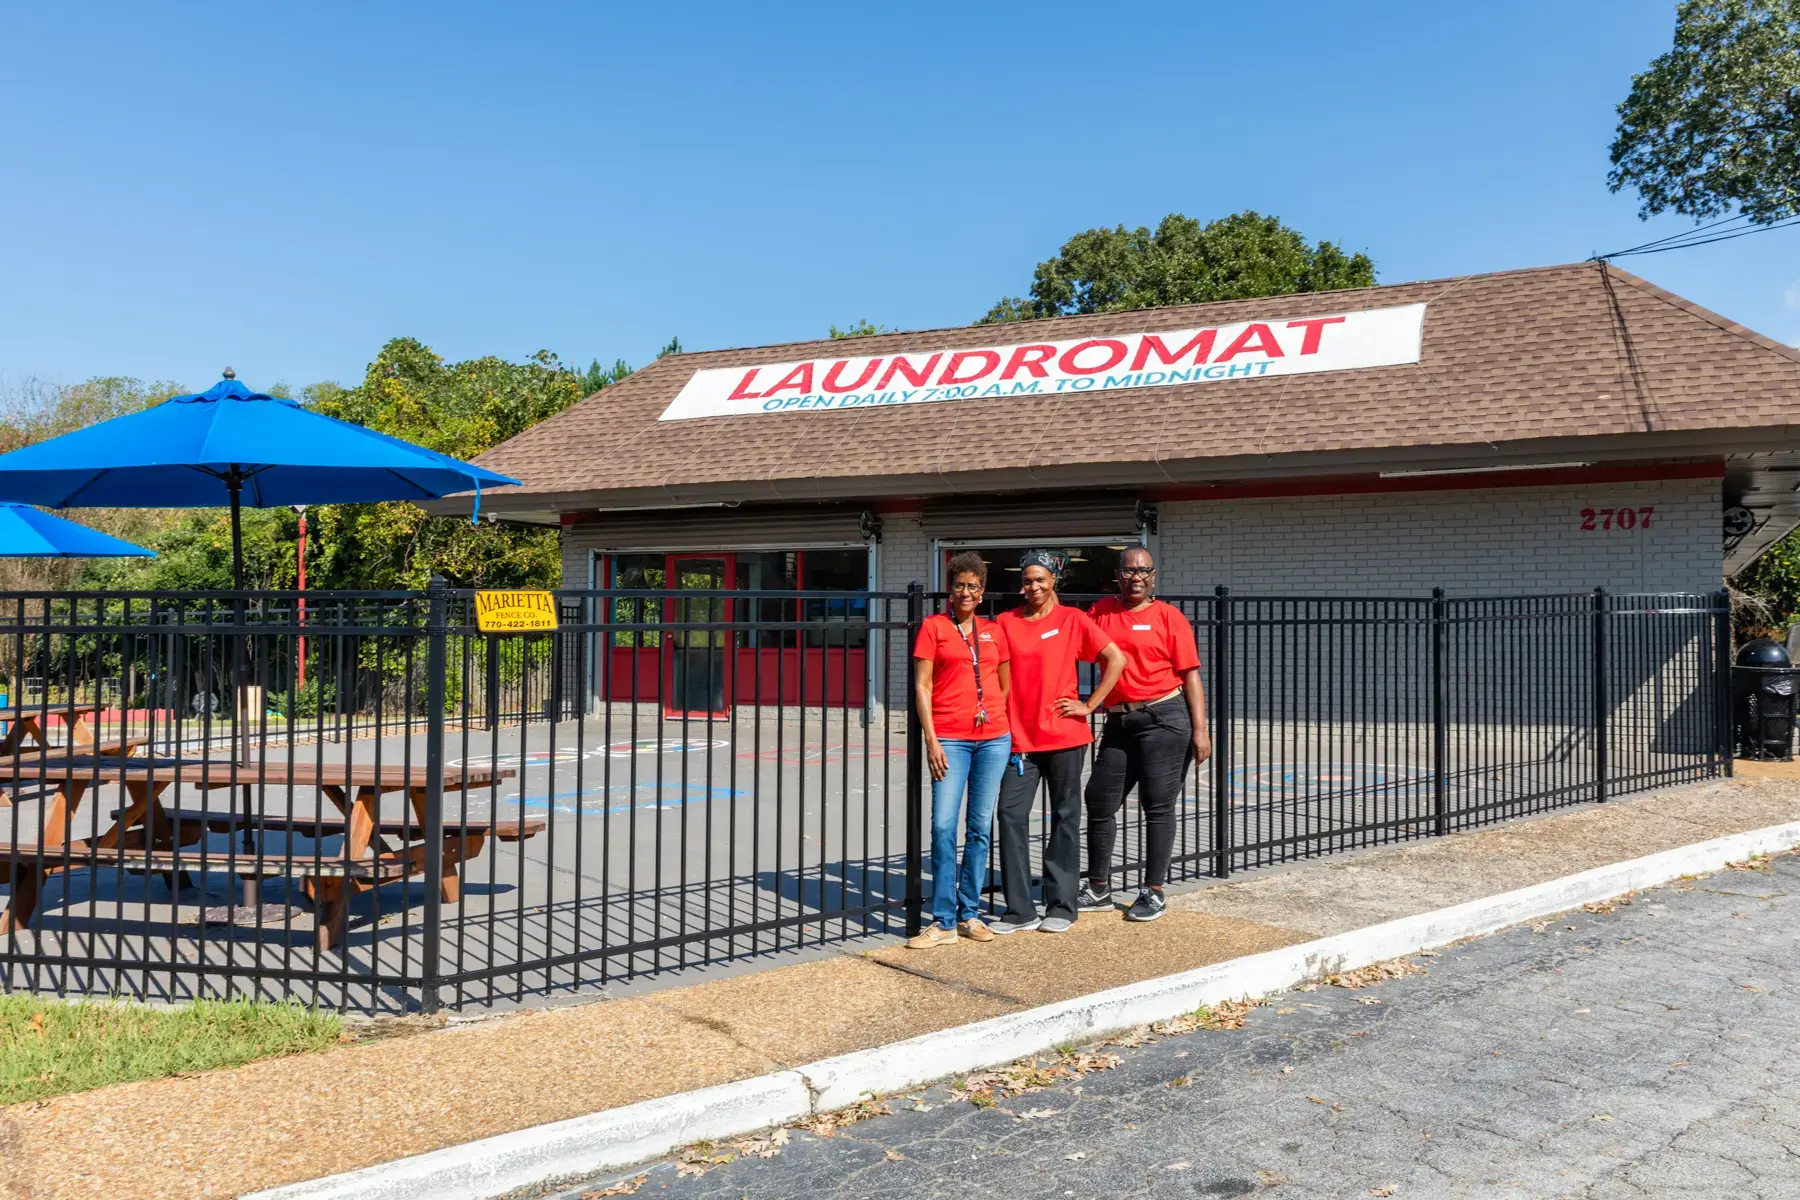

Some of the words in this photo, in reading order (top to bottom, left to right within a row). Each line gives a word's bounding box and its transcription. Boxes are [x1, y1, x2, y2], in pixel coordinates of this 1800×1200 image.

[727, 316, 1346, 400] LAUNDROMAT
[762, 395, 836, 411] OPEN
[839, 389, 919, 406] DAILY
[920, 384, 979, 401] 7:00
[979, 380, 1044, 396] A.M.
[1056, 377, 1095, 391] TO
[1103, 360, 1275, 388] MIDNIGHT
[1580, 507, 1654, 531] 2707
[479, 593, 553, 615] MARIETTA
[495, 611, 522, 619] FENCE
[523, 611, 538, 619] CO.
[485, 620, 551, 628] 770-422-1811
